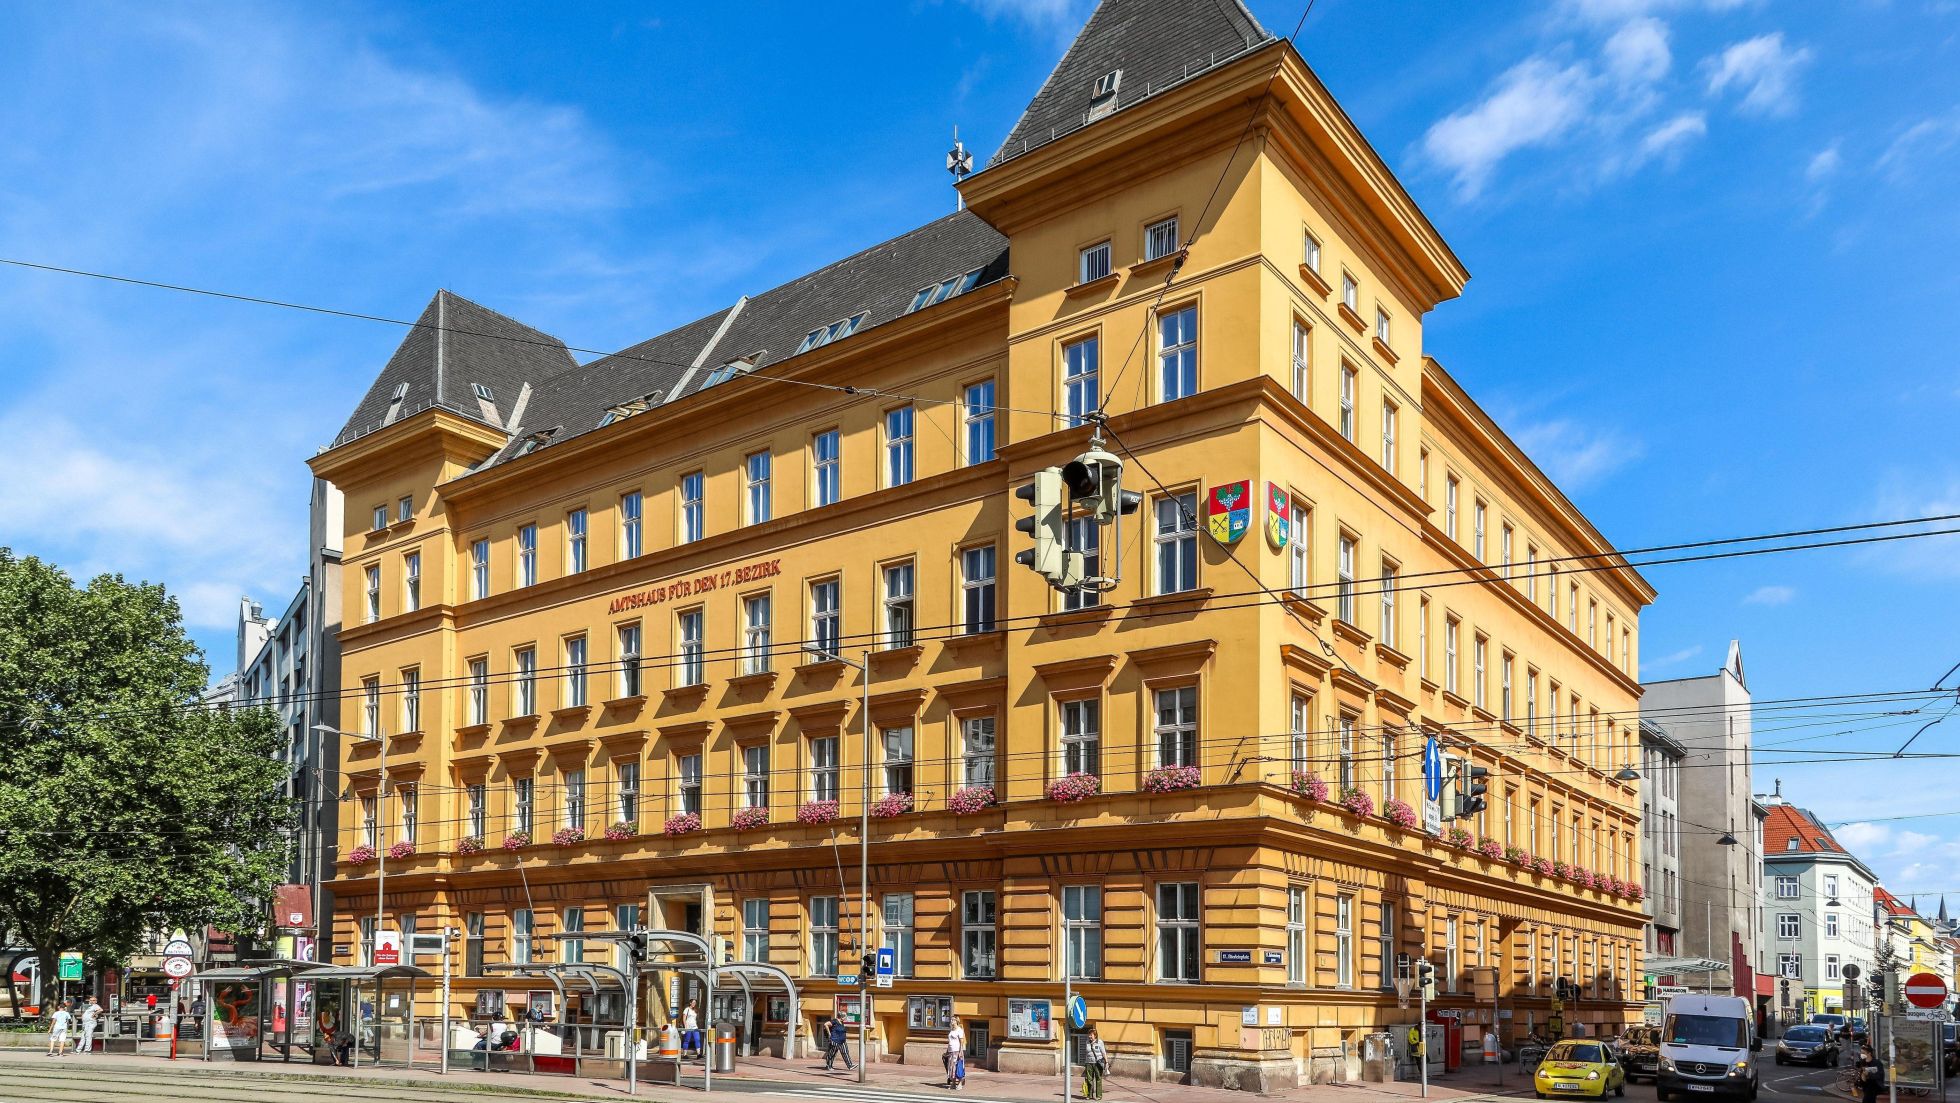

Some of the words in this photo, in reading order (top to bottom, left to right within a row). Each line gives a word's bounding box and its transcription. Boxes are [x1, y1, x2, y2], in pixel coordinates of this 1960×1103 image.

[608, 587, 666, 615] AMTSHAUS
[668, 580, 692, 601] FÜR
[693, 574, 718, 595] DEN
